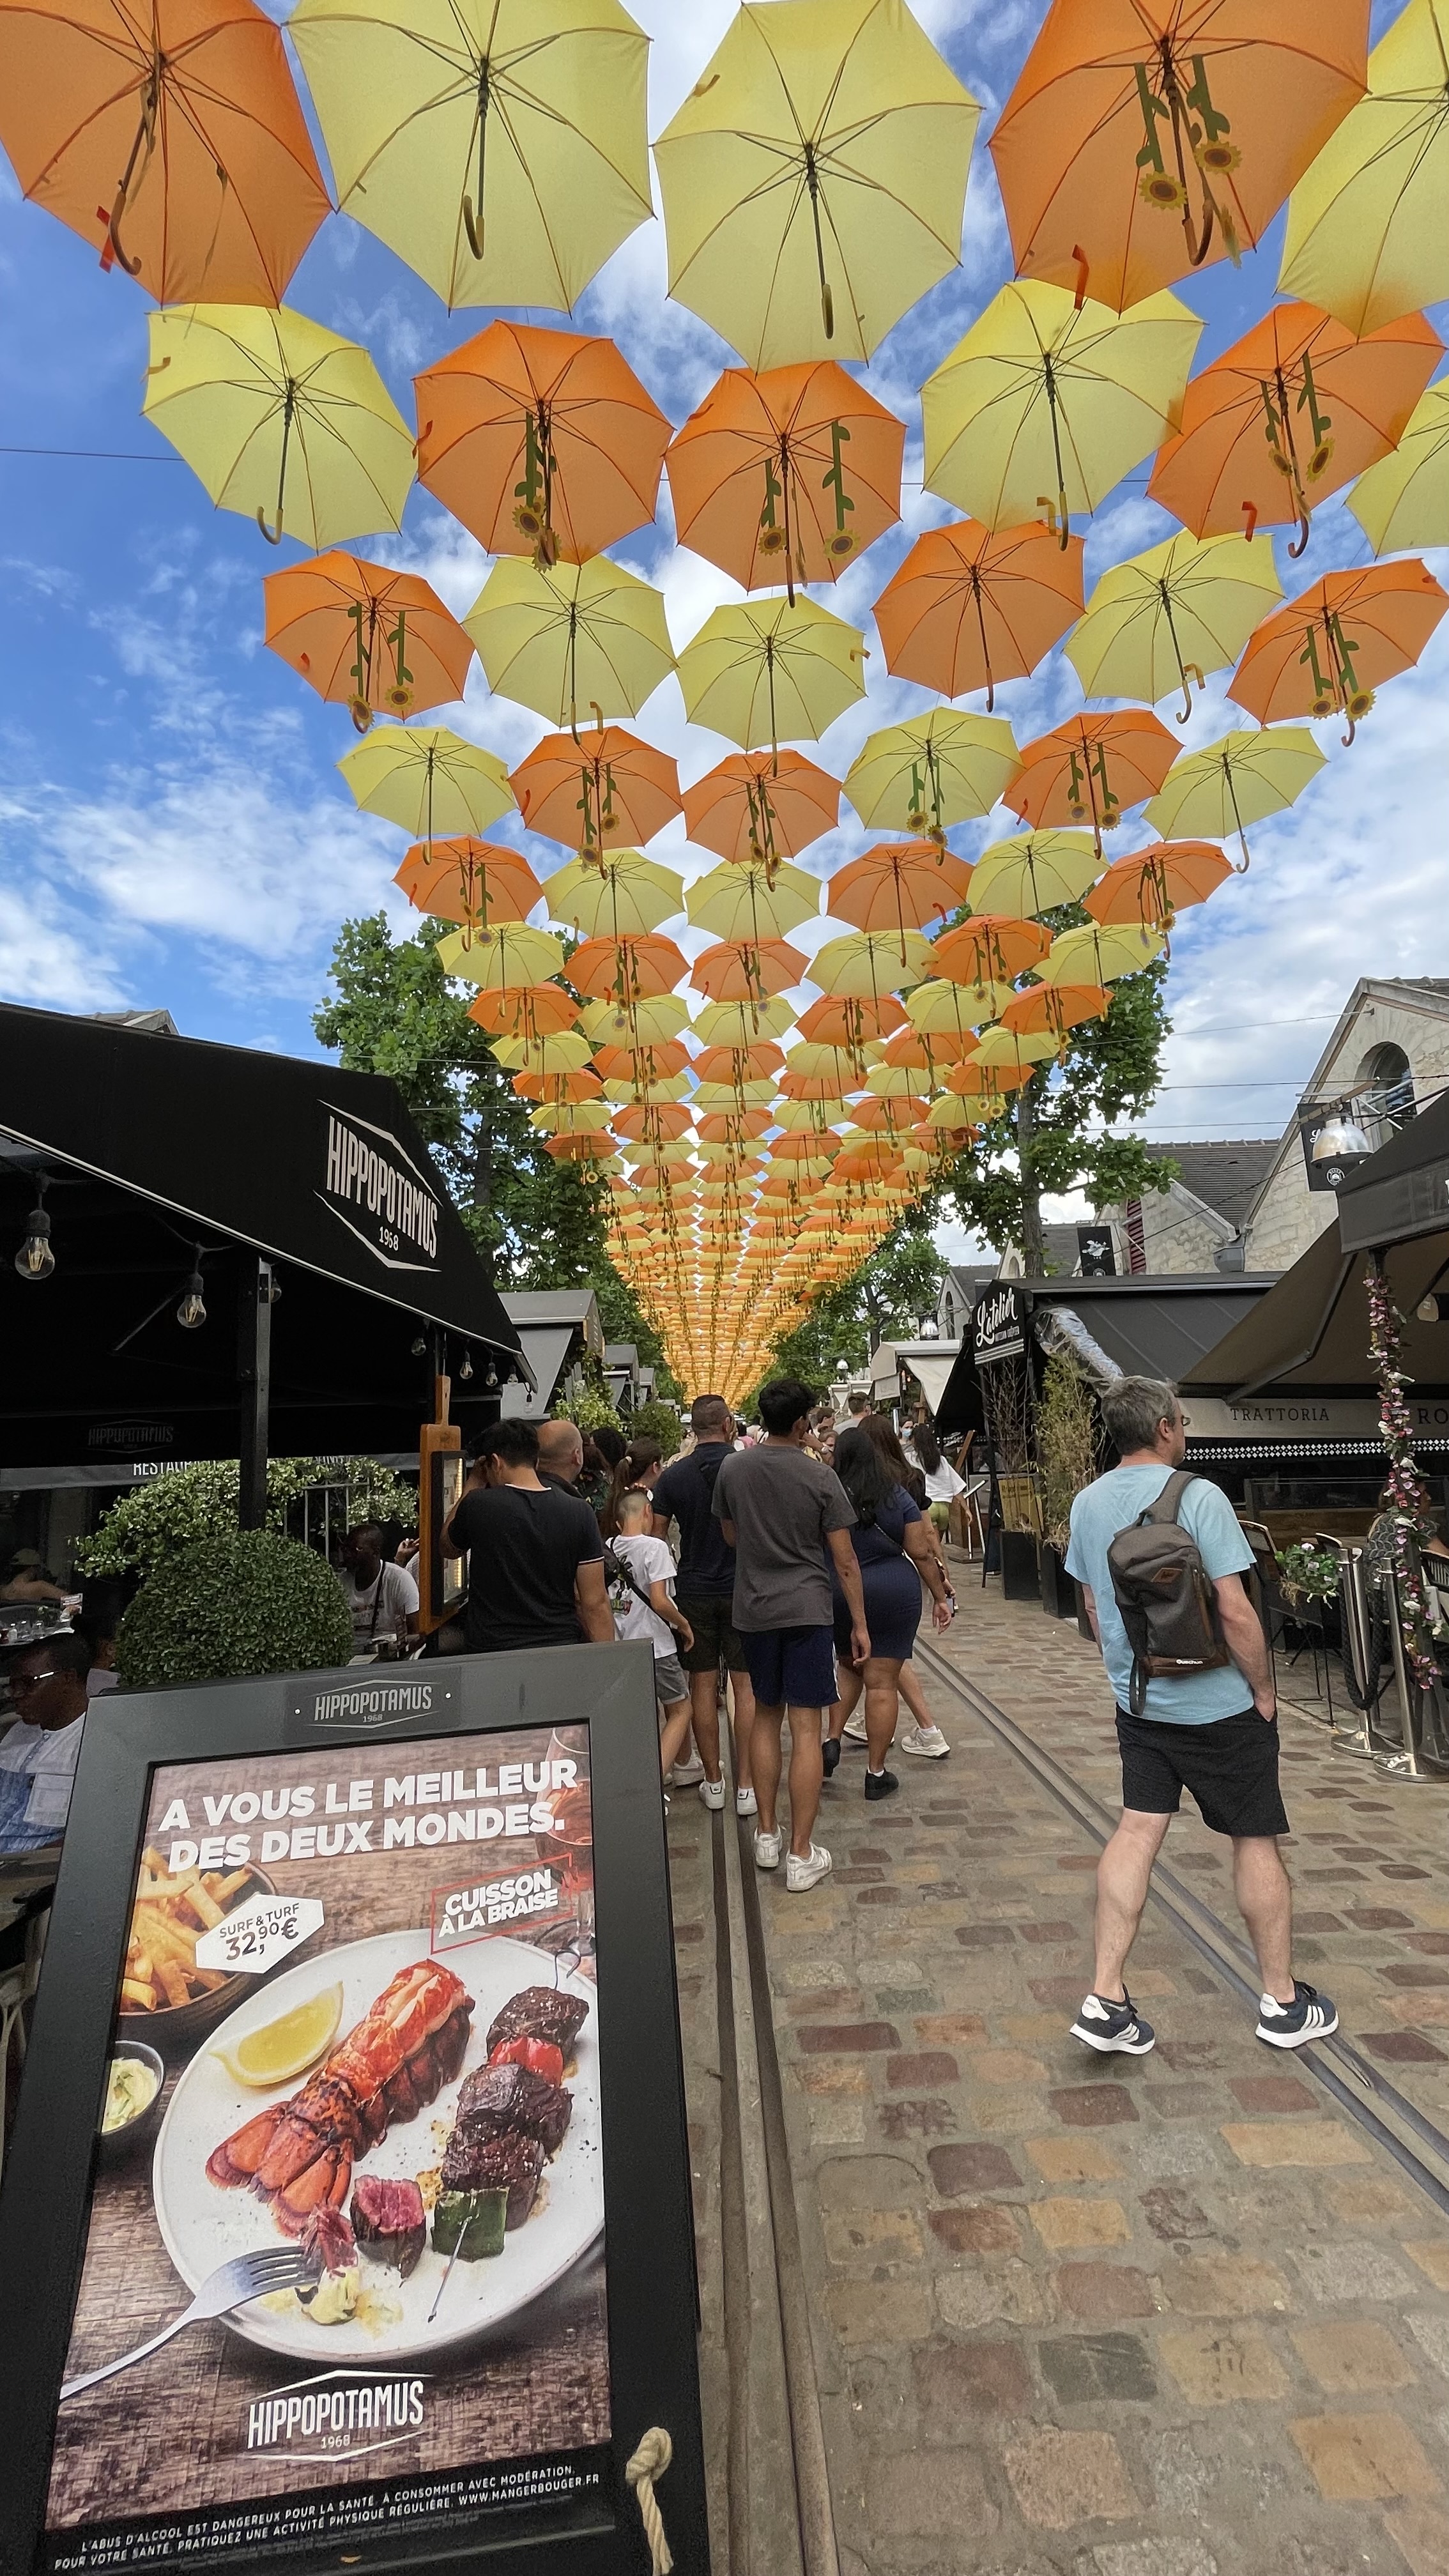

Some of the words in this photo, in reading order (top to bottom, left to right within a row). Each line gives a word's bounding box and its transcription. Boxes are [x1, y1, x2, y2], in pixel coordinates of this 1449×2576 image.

[326, 1116, 438, 1259] HIPPOPOTAMUS
[379, 1227, 399, 1251] 1968
[1230, 1408, 1330, 1422] TRATTORIA
[314, 1685, 432, 1721] HIPPOPOTAMUS
[362, 1714, 383, 1723] 1968
[158, 1799, 190, 1831] A
[203, 1786, 316, 1827] VOUS
[325, 1779, 374, 1814] LE
[383, 1759, 578, 1808] MEILLEUR
[168, 1834, 251, 1873] DES
[261, 1820, 374, 1863] DEUX
[383, 1802, 565, 1850] MONDES.
[438, 1914, 456, 1937] À
[457, 1909, 486, 1932] LA
[487, 1889, 558, 1924] BRAISE
[445, 1869, 551, 1916] CUISSON
[220, 1919, 253, 1938] SURF
[256, 1915, 263, 1926] &
[265, 1903, 299, 1922] TURF
[247, 2380, 424, 2450] HIPPOPOTAMUS
[321, 2435, 350, 2449] 1968
[54, 2556, 86, 2571] POUR
[90, 2550, 128, 2566] VOTRE
[178, 2531, 241, 2552] PRATIQUEZ
[246, 2527, 268, 2541] UNE
[273, 2517, 324, 2536] ACTIVITÉ
[330, 2508, 384, 2527] PHYSIQUE
[458, 2474, 599, 2506] WWW.MANGERBOUGER.FR
[82, 2536, 121, 2552] L'ABUS
[126, 2527, 182, 2546] D'ALCOOL
[187, 2522, 207, 2536] EST
[212, 2511, 280, 2532] DANGEREUX
[285, 2506, 315, 2520] POUR
[320, 2503, 334, 2514] LA
[395, 2481, 463, 2502] CONSOMMER
[468, 2477, 496, 2491] AVEC
